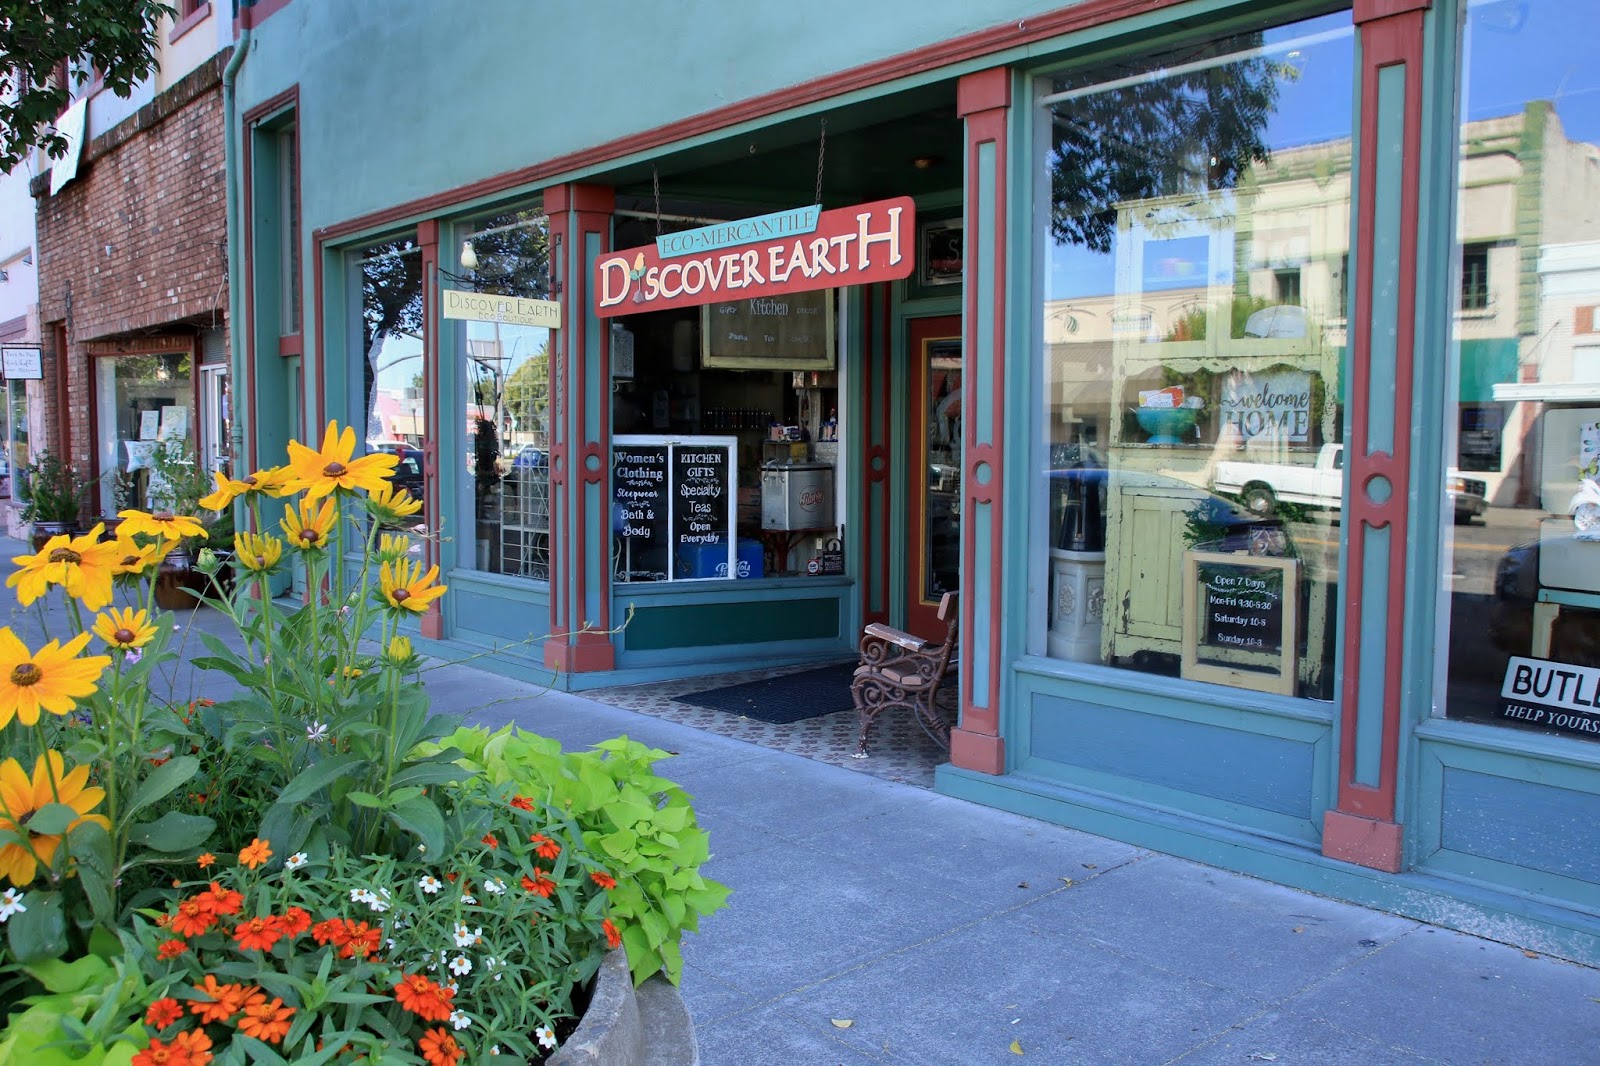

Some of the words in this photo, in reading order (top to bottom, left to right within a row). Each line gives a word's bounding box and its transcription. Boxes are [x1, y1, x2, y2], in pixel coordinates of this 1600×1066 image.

[662, 210, 814, 254] ECO-MERCANTILE
[768, 206, 903, 283] EARTH
[449, 292, 514, 314] DISCOVER
[517, 299, 558, 318] EARTH
[750, 298, 789, 316] Kitchen
[478, 311, 496, 320] ECO
[497, 312, 534, 325] BOUTIQUE
[1221, 382, 1309, 409] welcome
[1225, 410, 1309, 437] HOME
[614, 452, 665, 464] Women's
[680, 453, 722, 464] KITCHEN
[616, 467, 664, 482] Clothing
[686, 467, 715, 477] GIFTS
[616, 488, 659, 501] Sleepwear
[680, 483, 721, 498] Specialty
[620, 509, 644, 520] Bath
[646, 509, 655, 520] &
[688, 500, 712, 514] Teas
[622, 524, 651, 539] Body
[689, 521, 711, 532] Open
[680, 532, 720, 545] Everyday
[1215, 575, 1236, 586] Open
[1237, 577, 1243, 586] 7
[1245, 578, 1266, 590] Days
[1210, 595, 1237, 607] Mon-Fri
[1214, 612, 1248, 627] Saturday
[1217, 632, 1245, 646] Sunday
[1504, 704, 1545, 722] HELP
[1547, 711, 1600, 734] YOURS
